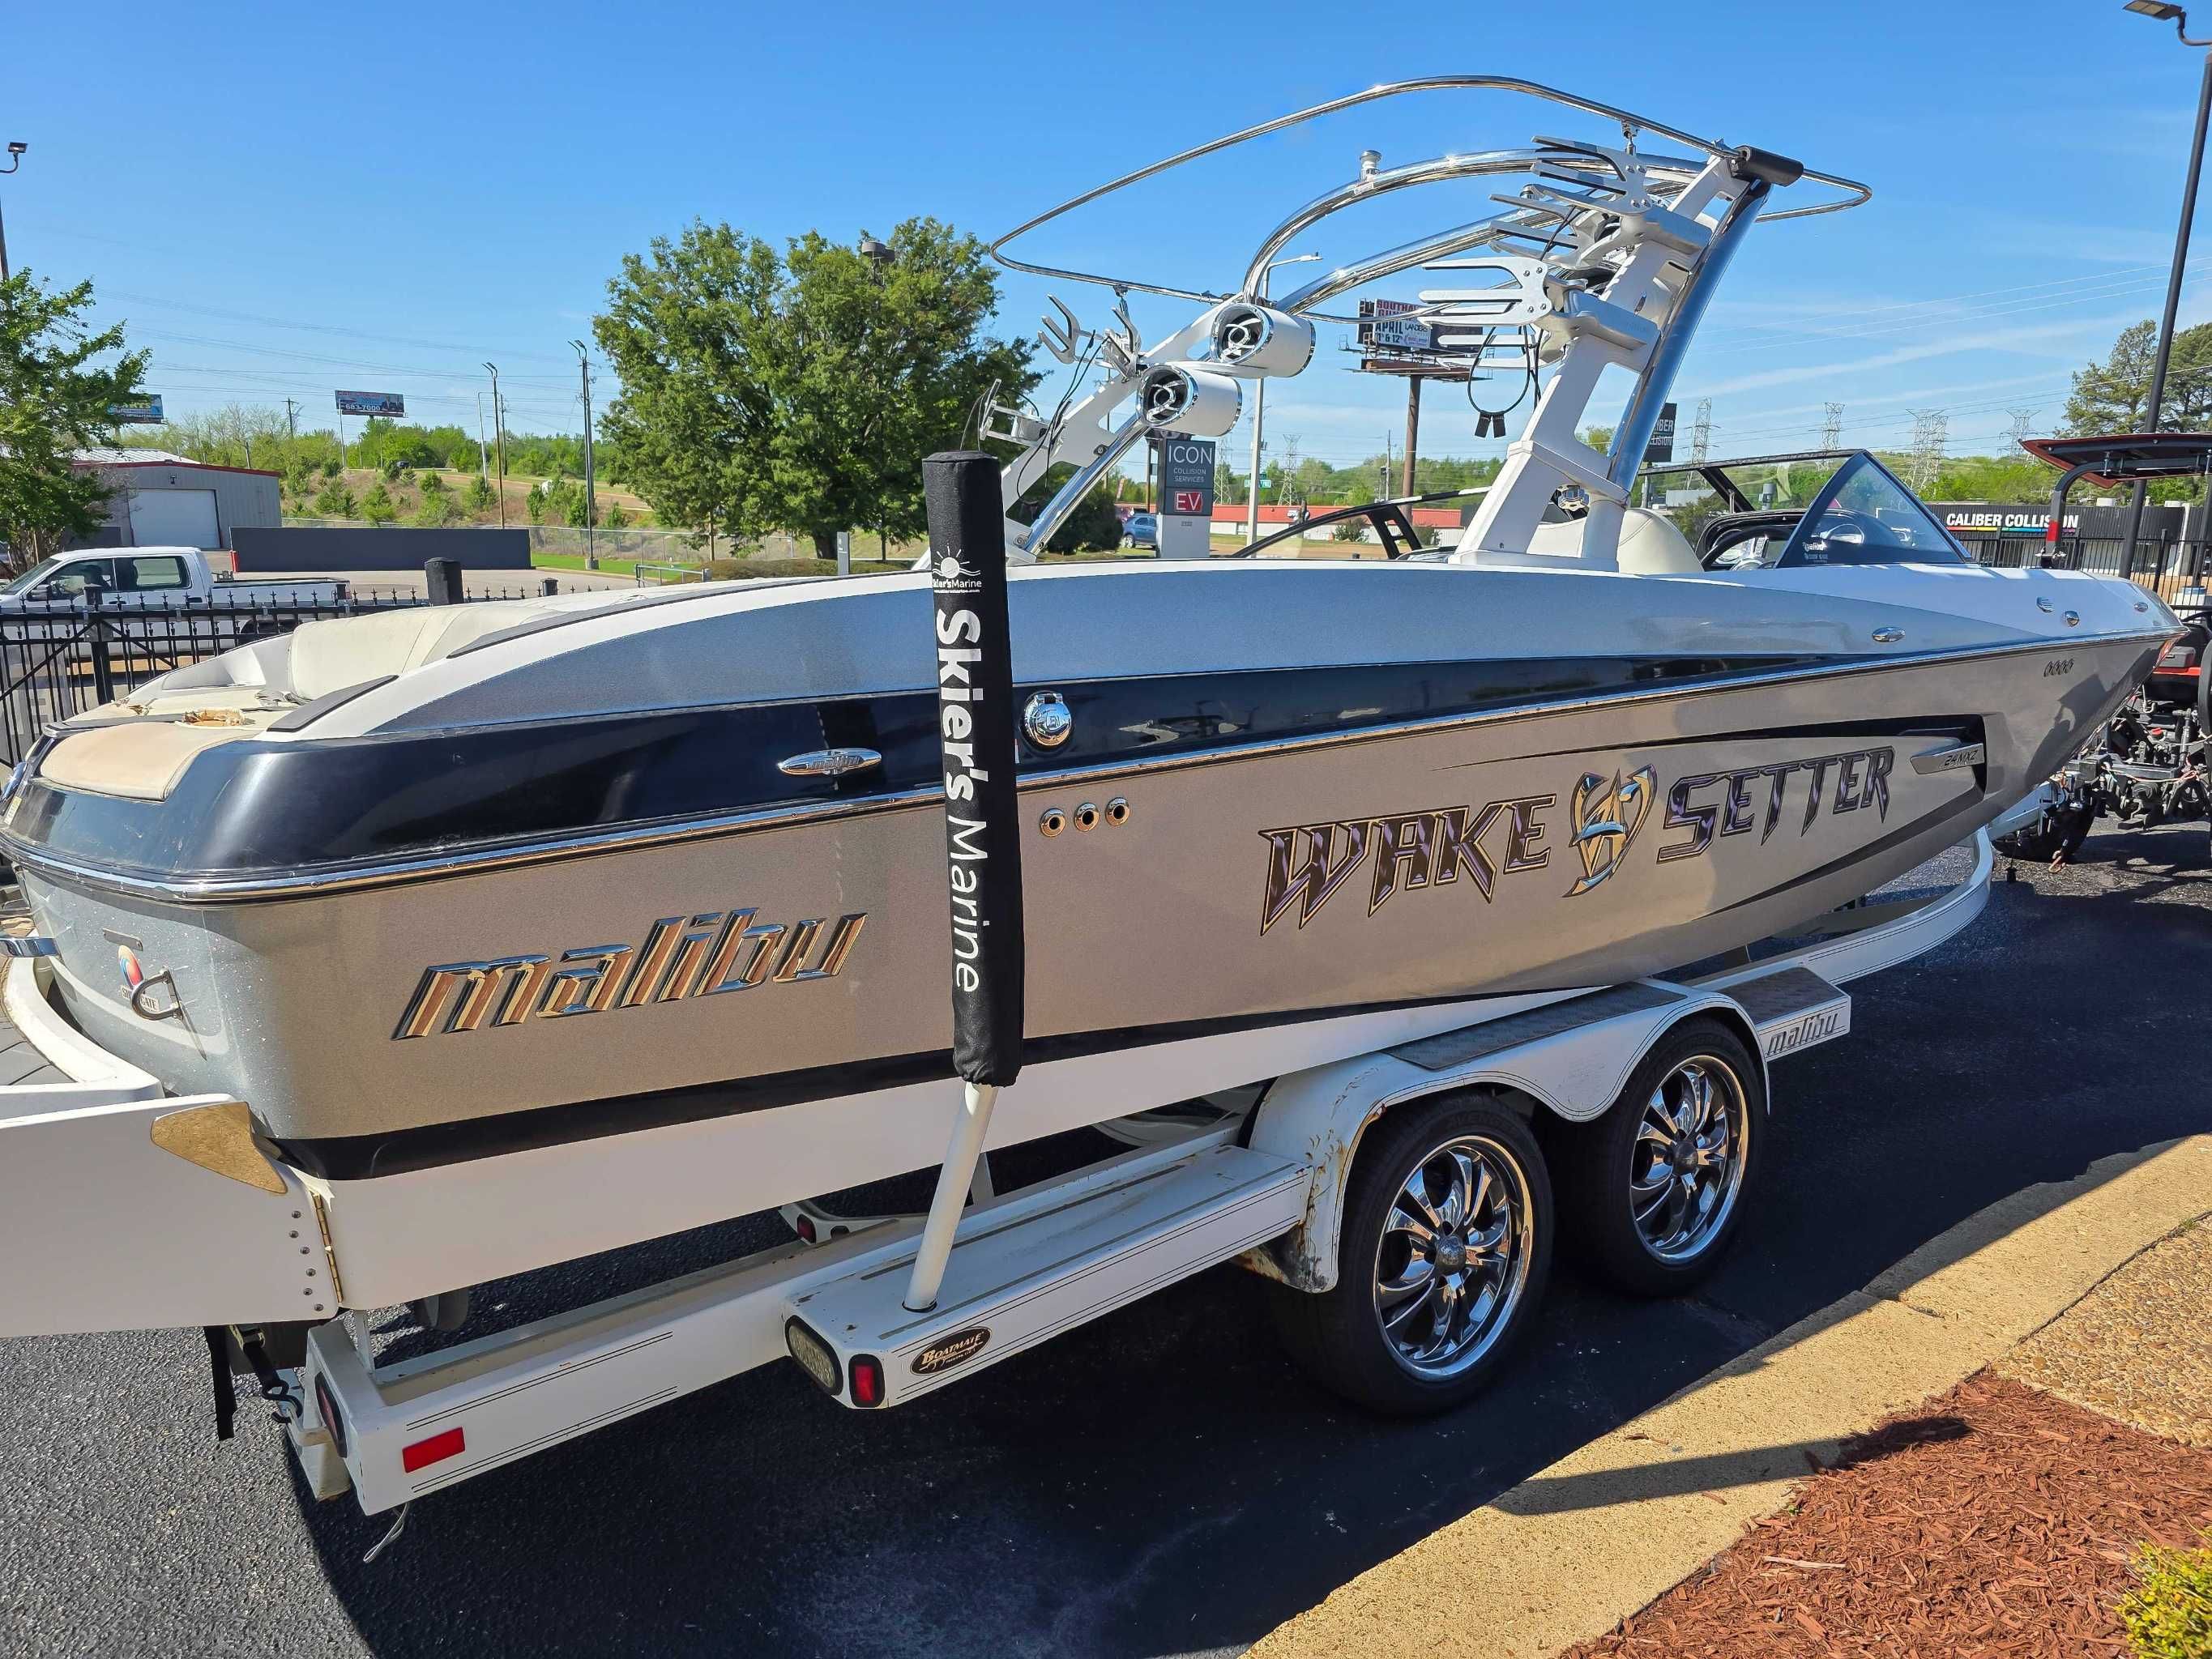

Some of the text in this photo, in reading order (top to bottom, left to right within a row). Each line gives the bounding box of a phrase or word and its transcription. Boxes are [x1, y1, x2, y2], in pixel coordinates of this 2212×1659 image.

[1655, 420, 1673, 432] IBER
[1168, 445, 1212, 464] ICON
[1173, 467, 1206, 476] COLLISION
[1176, 493, 1201, 511] EV
[1946, 513, 2079, 528] CALIBER COLLISN
[937, 609, 989, 802] Skier's
[1258, 746, 1897, 936] WAKE SETTER
[946, 815, 990, 992] Marine
[390, 907, 869, 1041] malibu
[1766, 1013, 1838, 1056] malibu
[921, 1333, 983, 1365] BOATMATE
